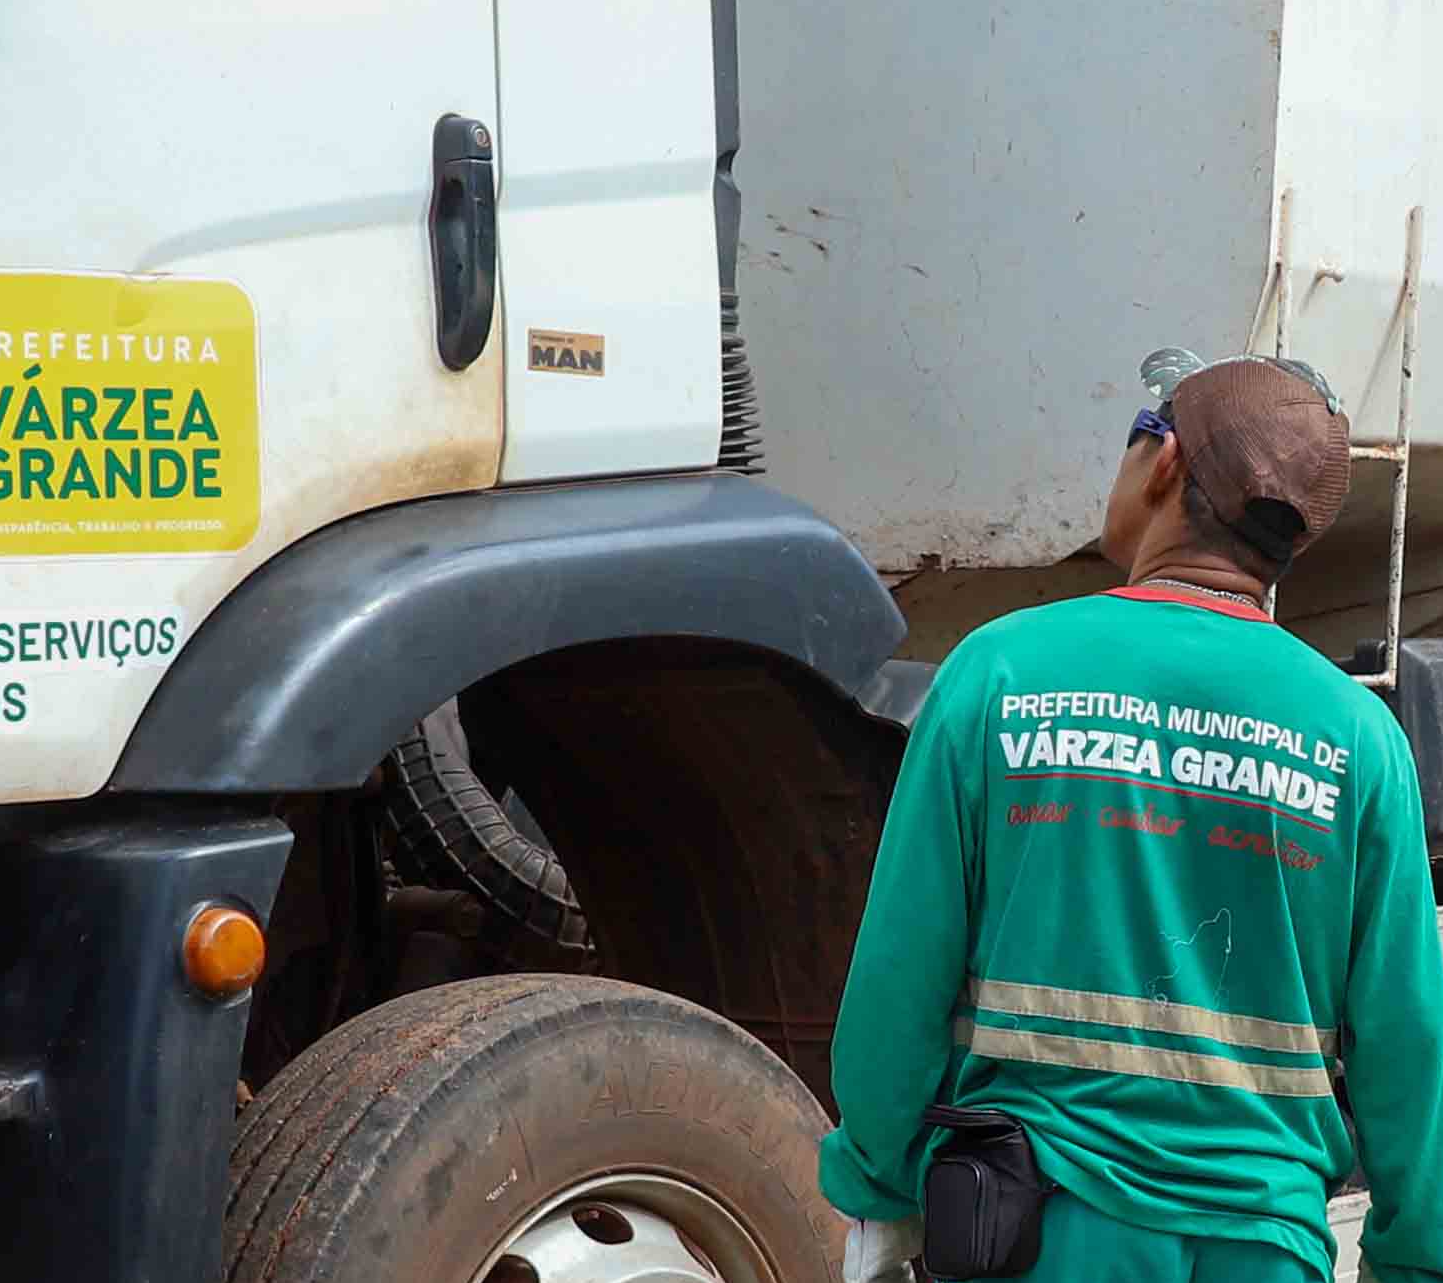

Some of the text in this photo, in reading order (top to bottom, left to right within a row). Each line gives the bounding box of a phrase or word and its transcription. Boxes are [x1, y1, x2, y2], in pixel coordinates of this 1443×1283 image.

[531, 345, 603, 372] MAN
[999, 720, 1342, 822] VÁRZEA GRANDE
[1002, 691, 1350, 775] PREFEITURA MUNICIPAL DE
